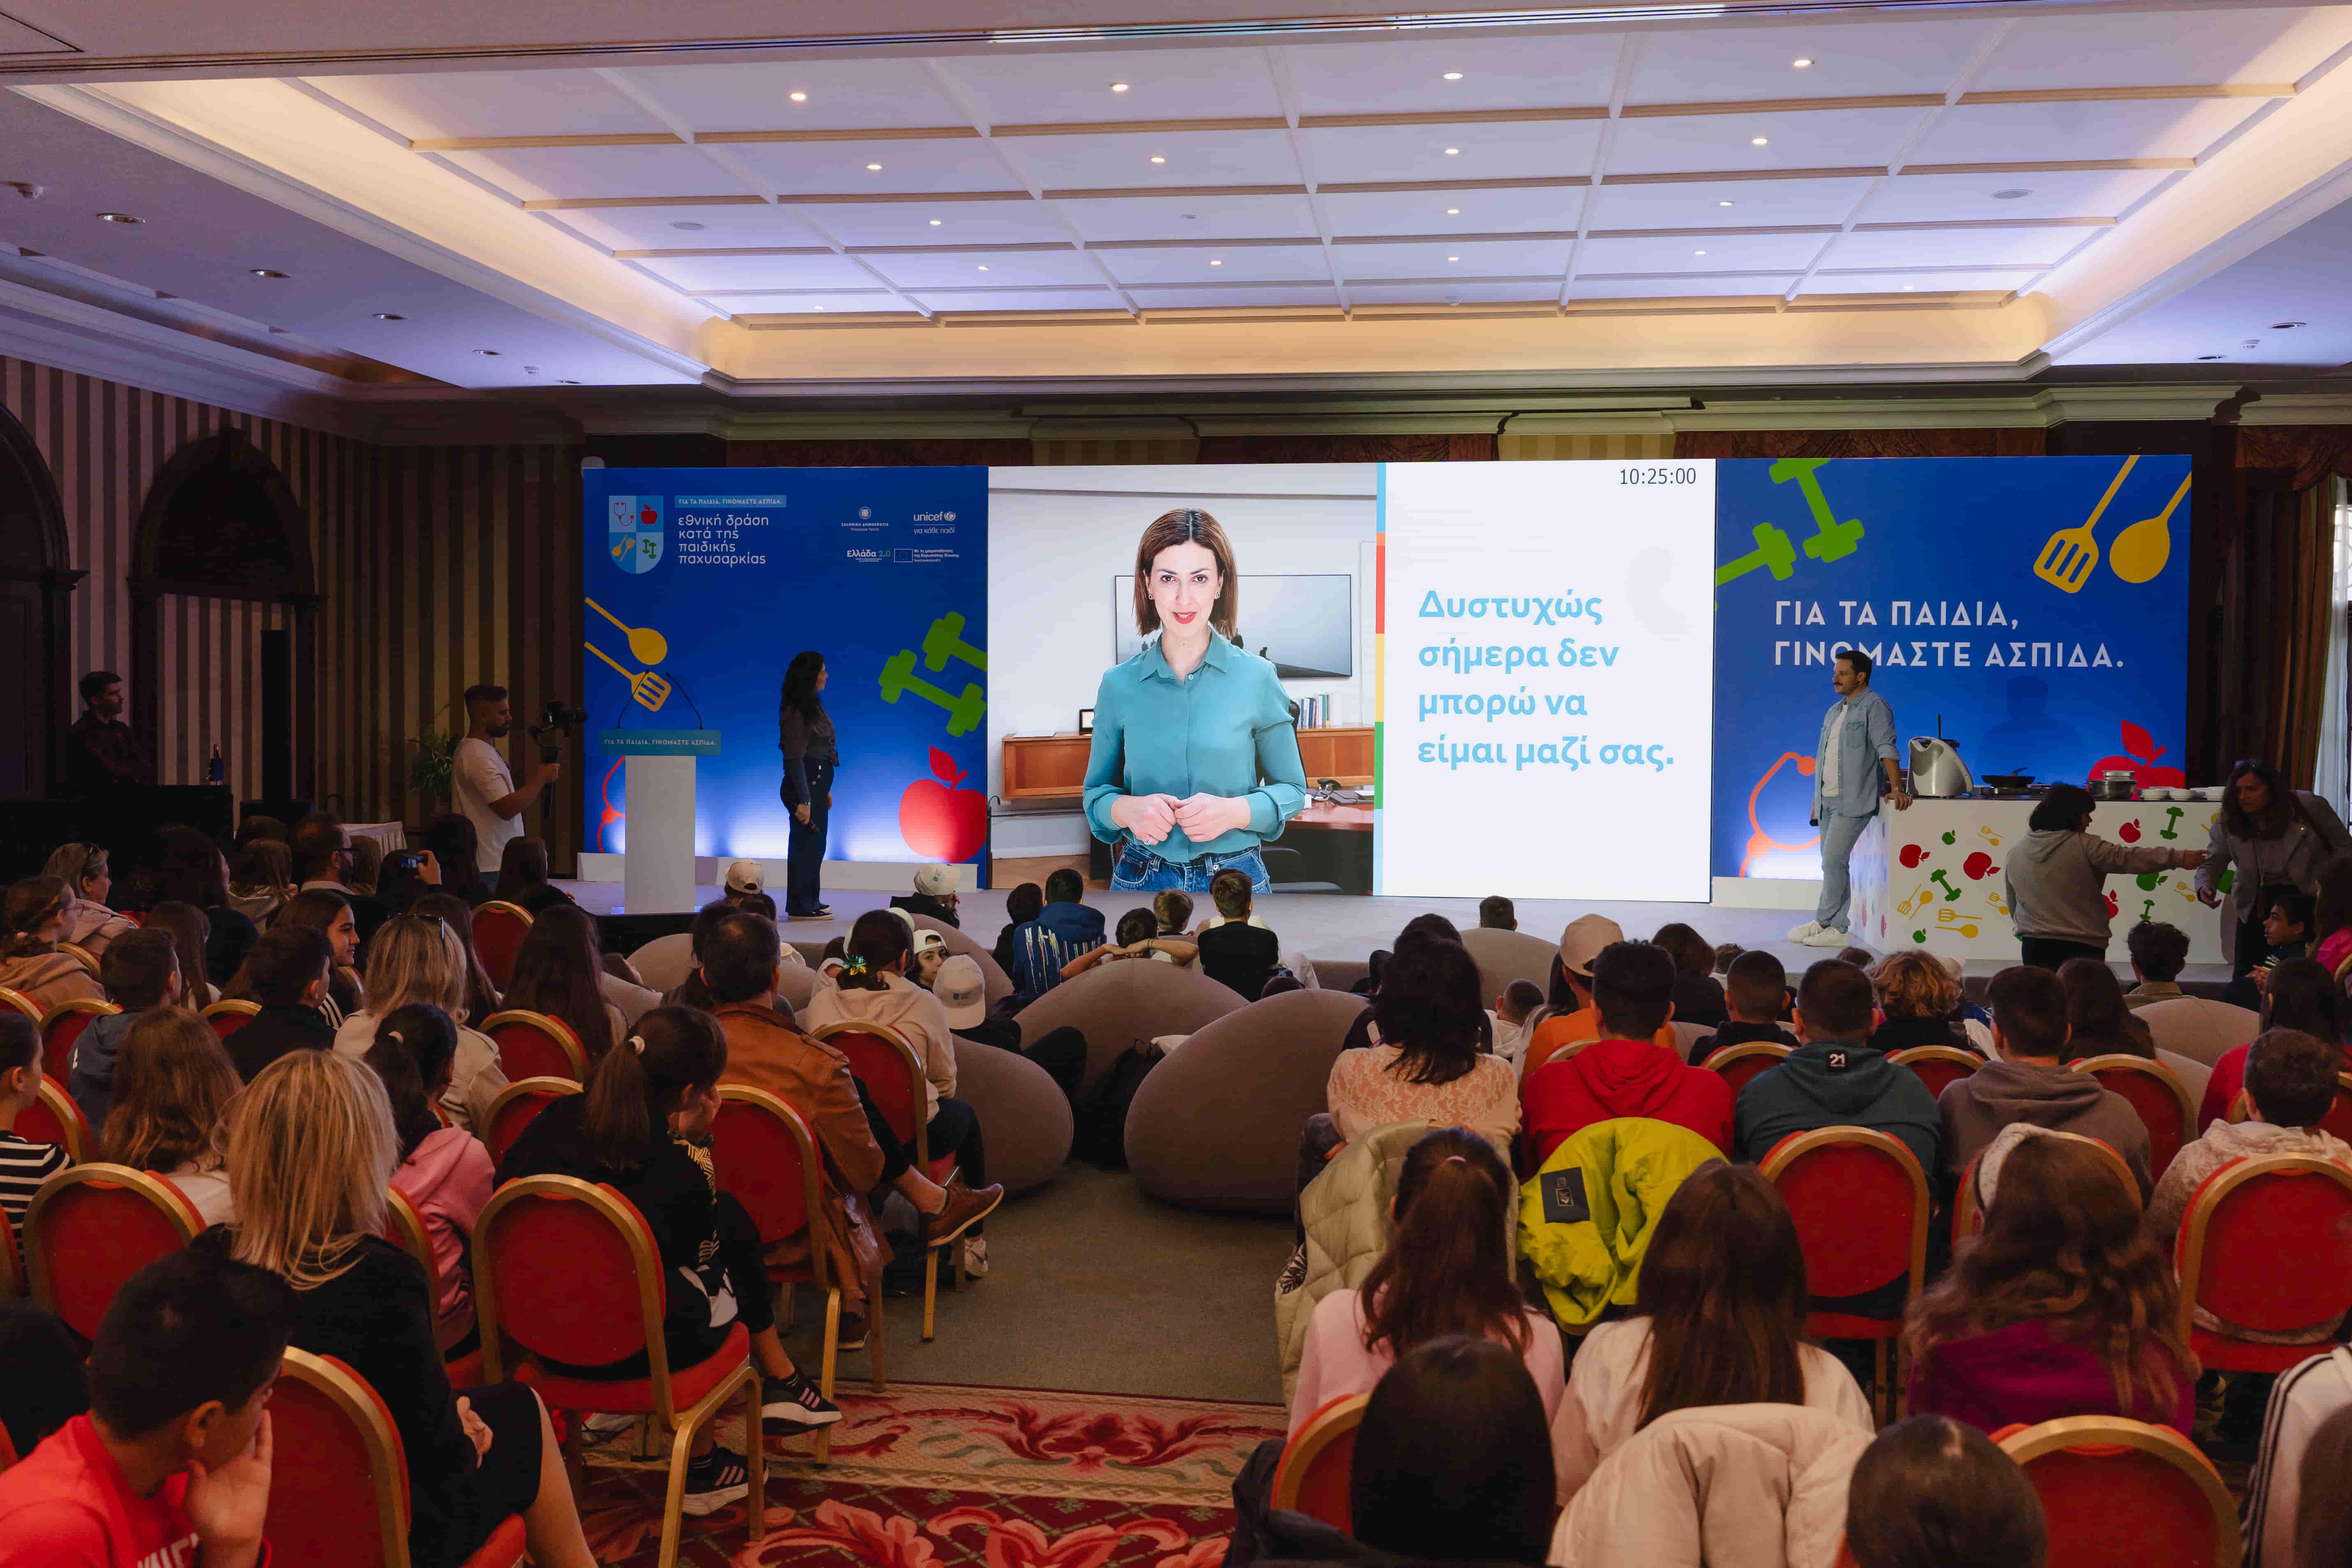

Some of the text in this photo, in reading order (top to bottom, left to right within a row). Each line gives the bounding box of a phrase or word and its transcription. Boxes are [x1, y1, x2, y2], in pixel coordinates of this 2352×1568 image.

[1620, 468, 1696, 485] 10:25:00
[678, 513, 769, 530] εθνική δράση
[914, 511, 943, 522] unicef
[679, 526, 739, 539] κατά της
[678, 540, 736, 552] παιδικής
[847, 549, 877, 557] Ελλάδα
[678, 552, 766, 568] παχυσαρκίας
[1418, 588, 1603, 626] Δυστυχώς
[1775, 600, 2018, 630] ΓΙΑ ΤΑ ΠΑΙΔΙΑ,
[1418, 637, 1620, 674] σήμερα δεν
[1984, 642, 2123, 667] ΑΣΠΙΔΑ.
[1418, 686, 1588, 723] μπορώ να
[1417, 734, 1674, 773] είμαι μαζί σας.
[1829, 1053, 1845, 1064] 21
